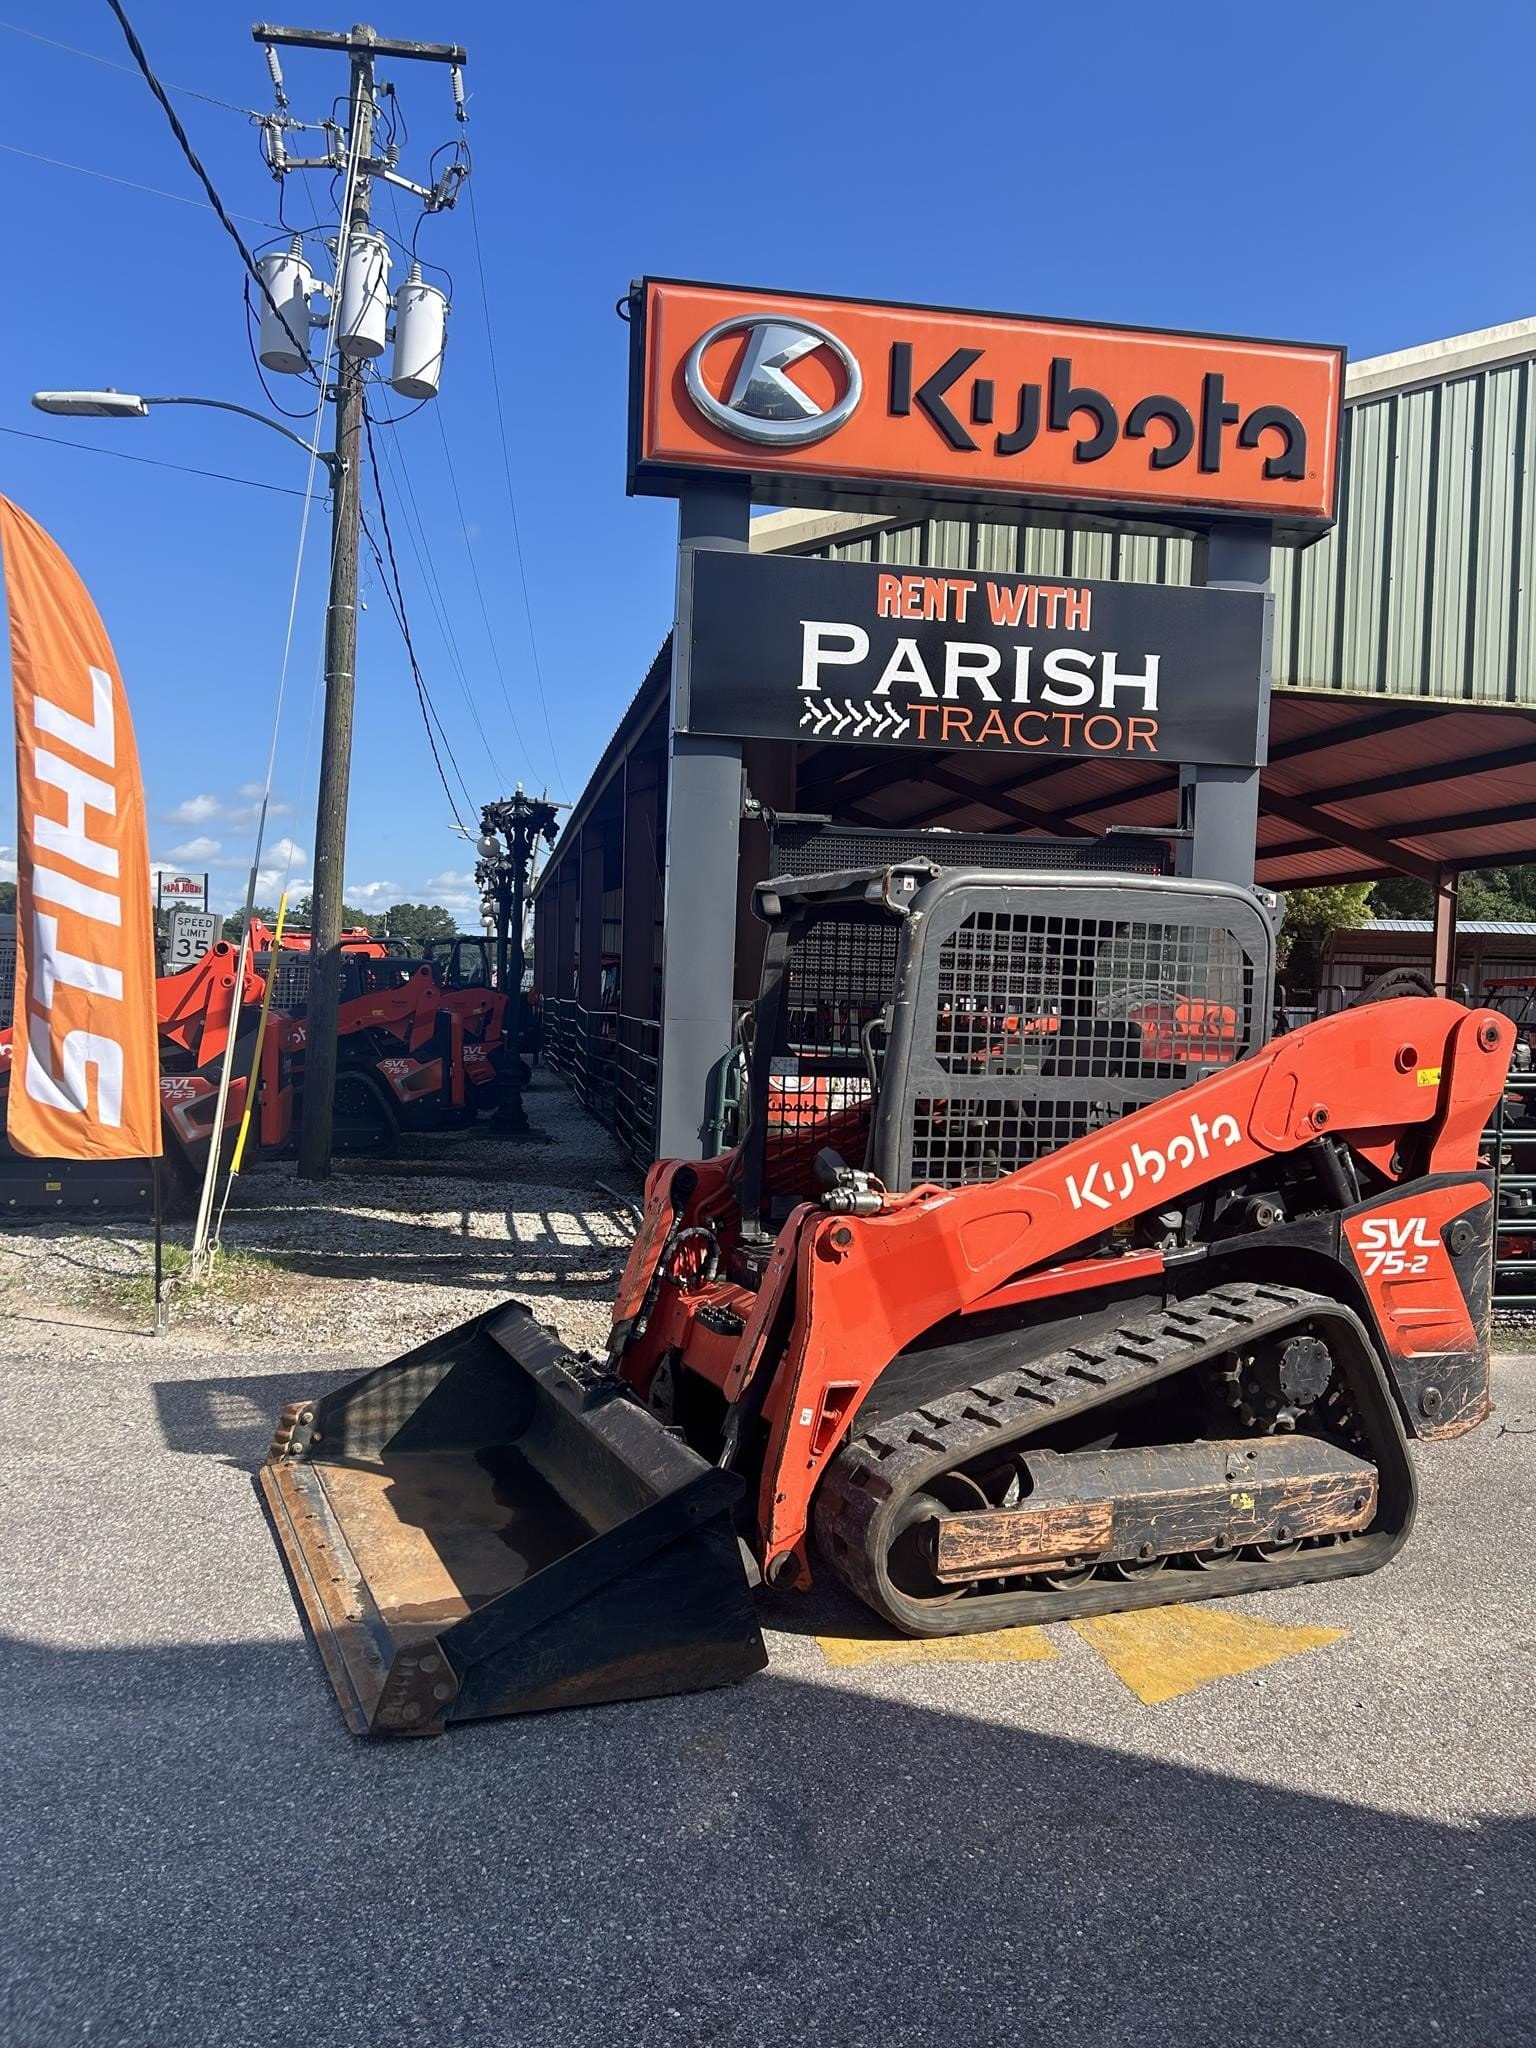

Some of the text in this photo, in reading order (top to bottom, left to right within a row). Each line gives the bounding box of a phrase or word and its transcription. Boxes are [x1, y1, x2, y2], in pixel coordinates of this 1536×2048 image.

[888, 341, 1307, 480] Kubota
[876, 573, 1092, 632] RENT WITH
[797, 620, 1161, 711] PARISH
[907, 702, 1160, 752] TRACTOR
[25, 665, 123, 1128] STIHL
[163, 883, 180, 893] PAPA
[177, 917, 213, 928] SPEED
[180, 928, 208, 938] LIMIT
[176, 939, 208, 958] 35
[383, 1060, 408, 1068] SVL
[160, 1079, 195, 1090] SVL
[164, 1090, 196, 1099] 75-3
[1065, 1113, 1242, 1210] Kubota
[1356, 1217, 1440, 1249] SVL
[1363, 1250, 1429, 1276] 75-2
